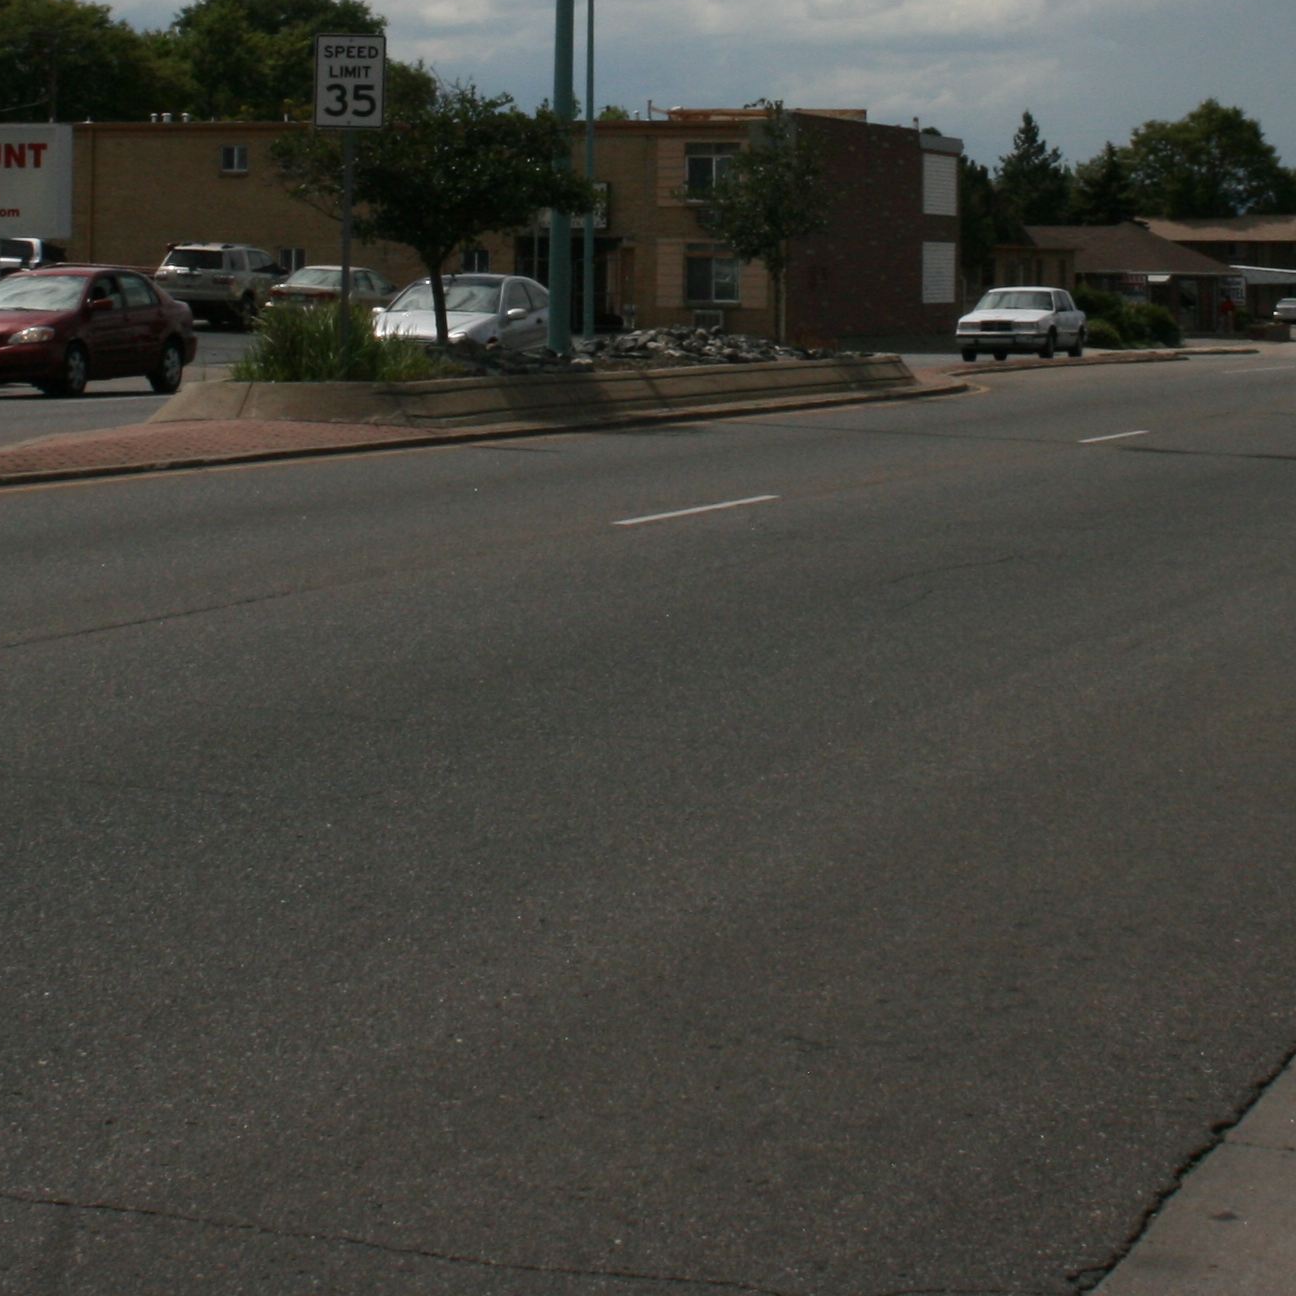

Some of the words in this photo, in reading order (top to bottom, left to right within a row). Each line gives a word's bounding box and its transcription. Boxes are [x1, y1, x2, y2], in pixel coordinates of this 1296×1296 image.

[324, 45, 379, 59] SPEED
[329, 66, 371, 78] LIMIT
[324, 83, 376, 117] 35
